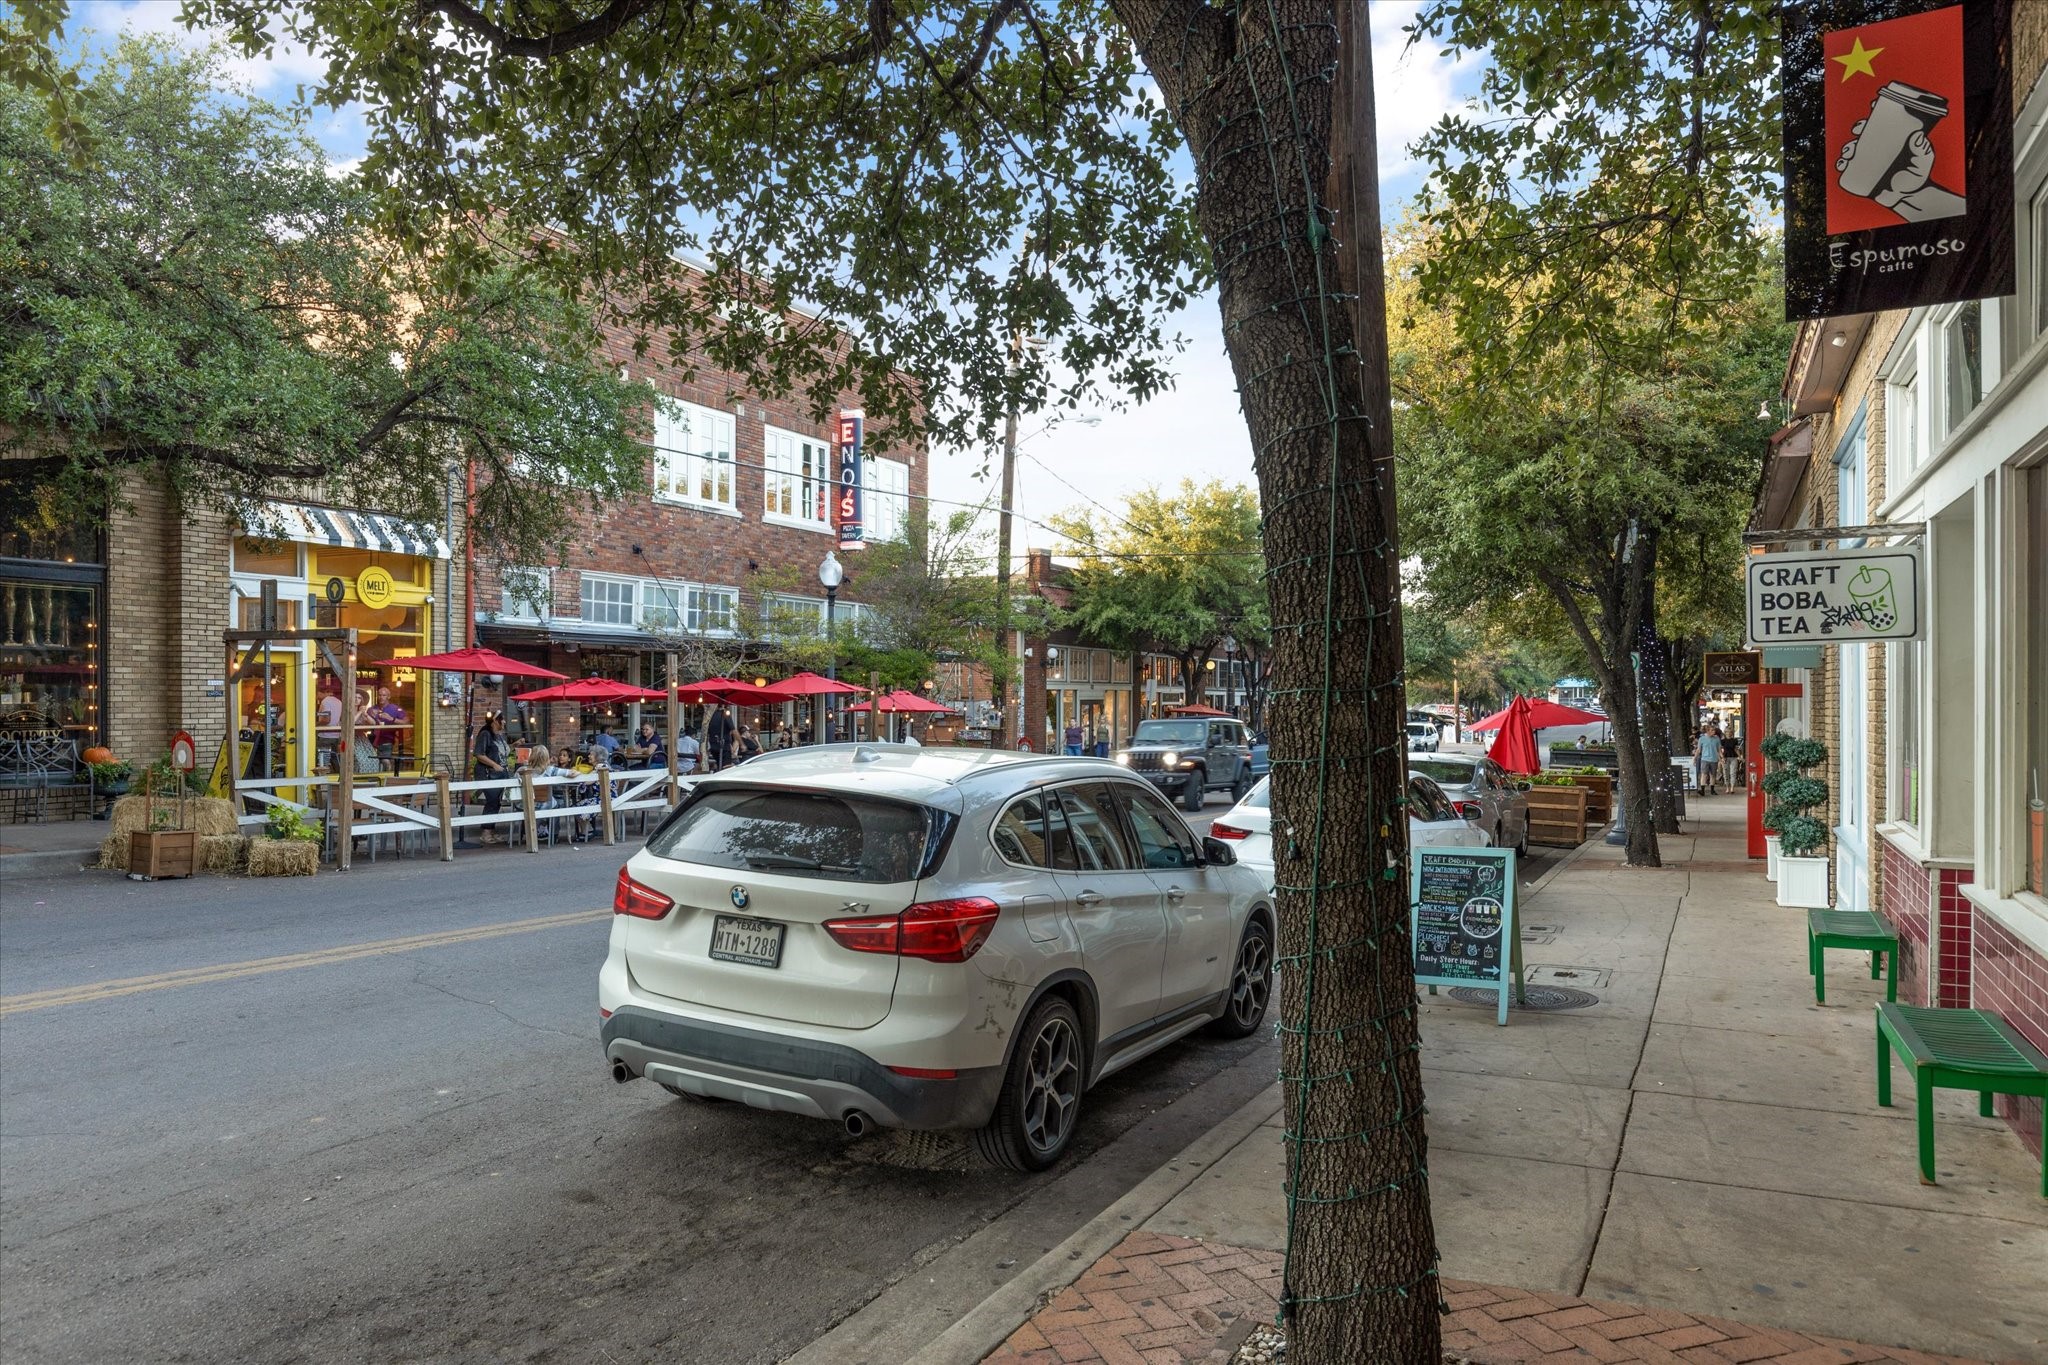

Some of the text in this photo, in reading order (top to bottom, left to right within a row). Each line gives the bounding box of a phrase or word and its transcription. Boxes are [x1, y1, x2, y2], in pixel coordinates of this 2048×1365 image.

[1829, 238, 1966, 275] Espumoso
[1879, 261, 1914, 273] caffe
[841, 422, 855, 517] ENO'S
[1759, 565, 1840, 587] CRAFT
[366, 580, 386, 591] MELT
[1760, 591, 1829, 611] BOBA
[1760, 616, 1811, 635] TEA
[838, 902, 870, 913] X1
[736, 921, 762, 932] TEXAS
[712, 952, 735, 961] CENTRAL
[1420, 954, 1438, 964] Daily
[1439, 956, 1459, 964] Store
